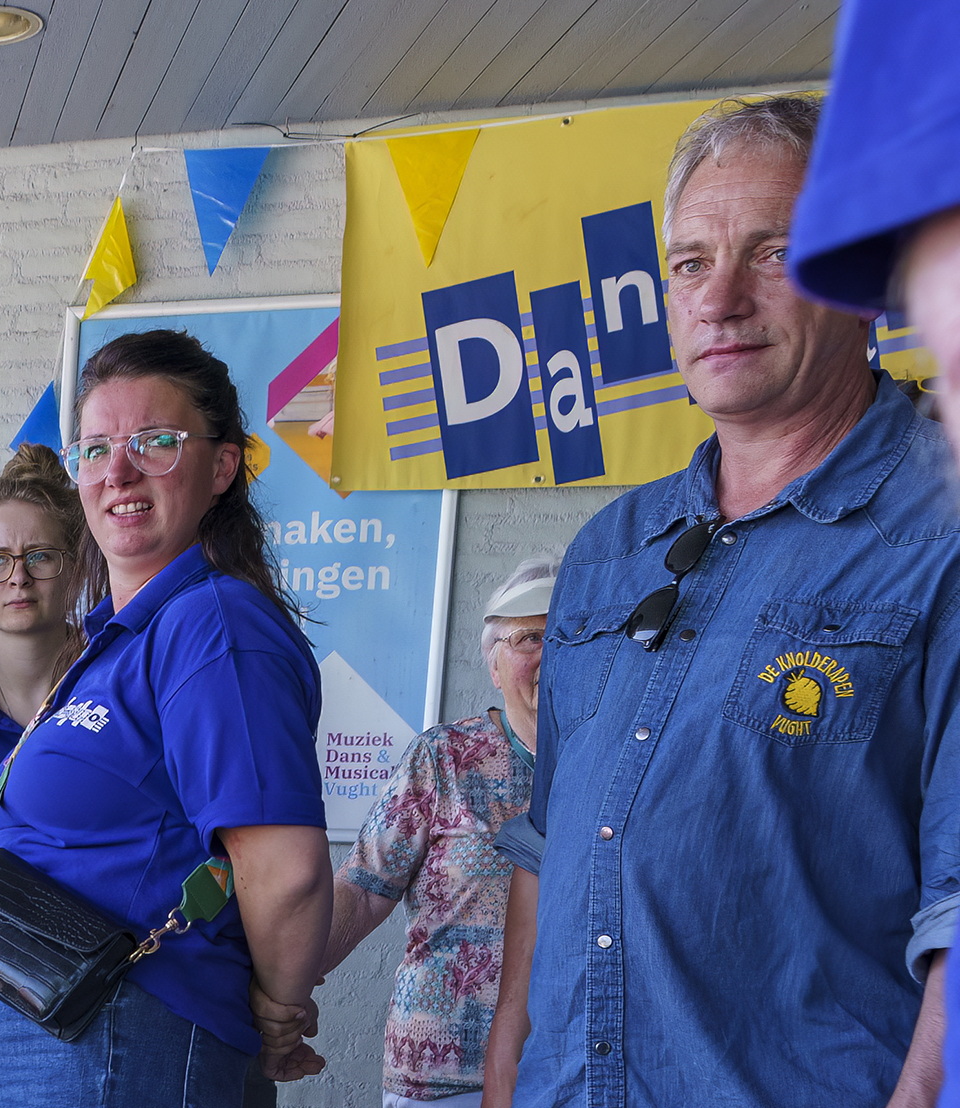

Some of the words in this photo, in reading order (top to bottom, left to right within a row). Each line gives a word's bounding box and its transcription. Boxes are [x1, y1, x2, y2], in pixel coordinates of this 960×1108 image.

[435, 269, 660, 434] Dan
[280, 558, 391, 600] ingen
[757, 664, 780, 684] DE
[775, 650, 855, 698] KNOLDERAPEN
[770, 714, 812, 736] VUGHT
[326, 731, 394, 747] Muziek
[325, 749, 372, 763] Dans
[377, 749, 390, 763] &
[323, 782, 378, 800] Vught
